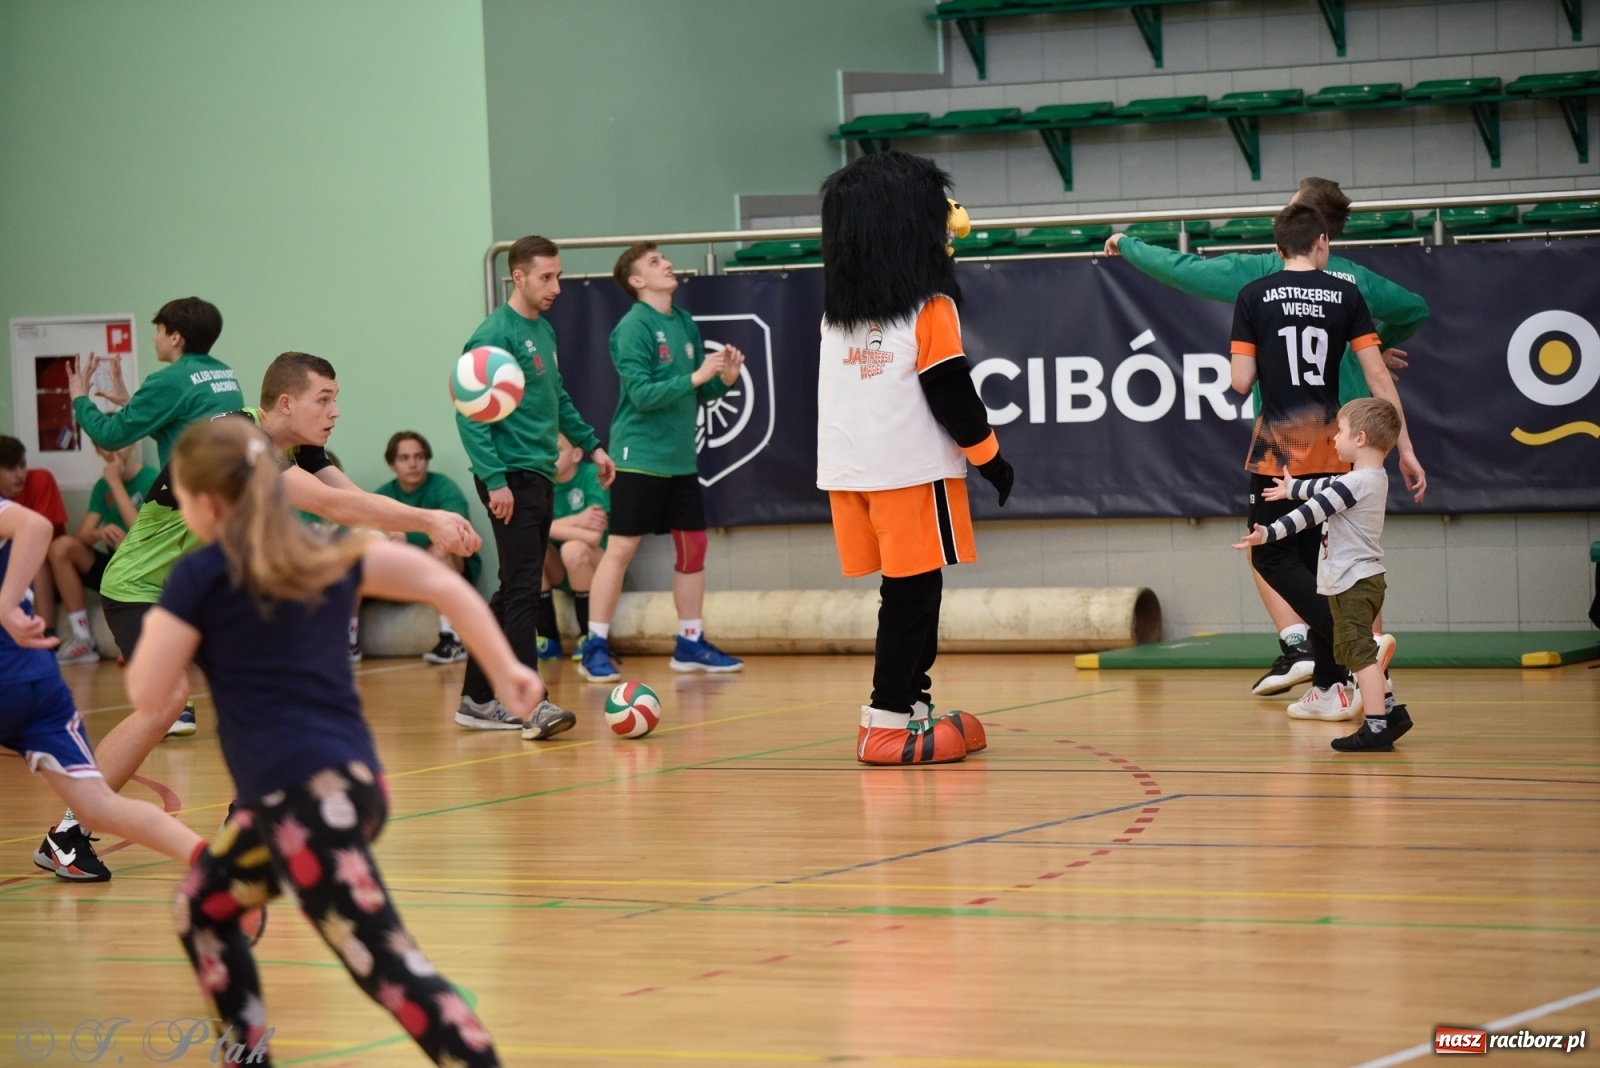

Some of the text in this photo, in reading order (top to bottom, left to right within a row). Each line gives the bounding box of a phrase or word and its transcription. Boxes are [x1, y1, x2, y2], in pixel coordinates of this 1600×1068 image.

[1262, 286, 1342, 304] JASTRZĘBSKI
[1281, 302, 1326, 319] WĘGIEL
[1277, 325, 1329, 387] 19
[970, 328, 1255, 426] CIBÓR
